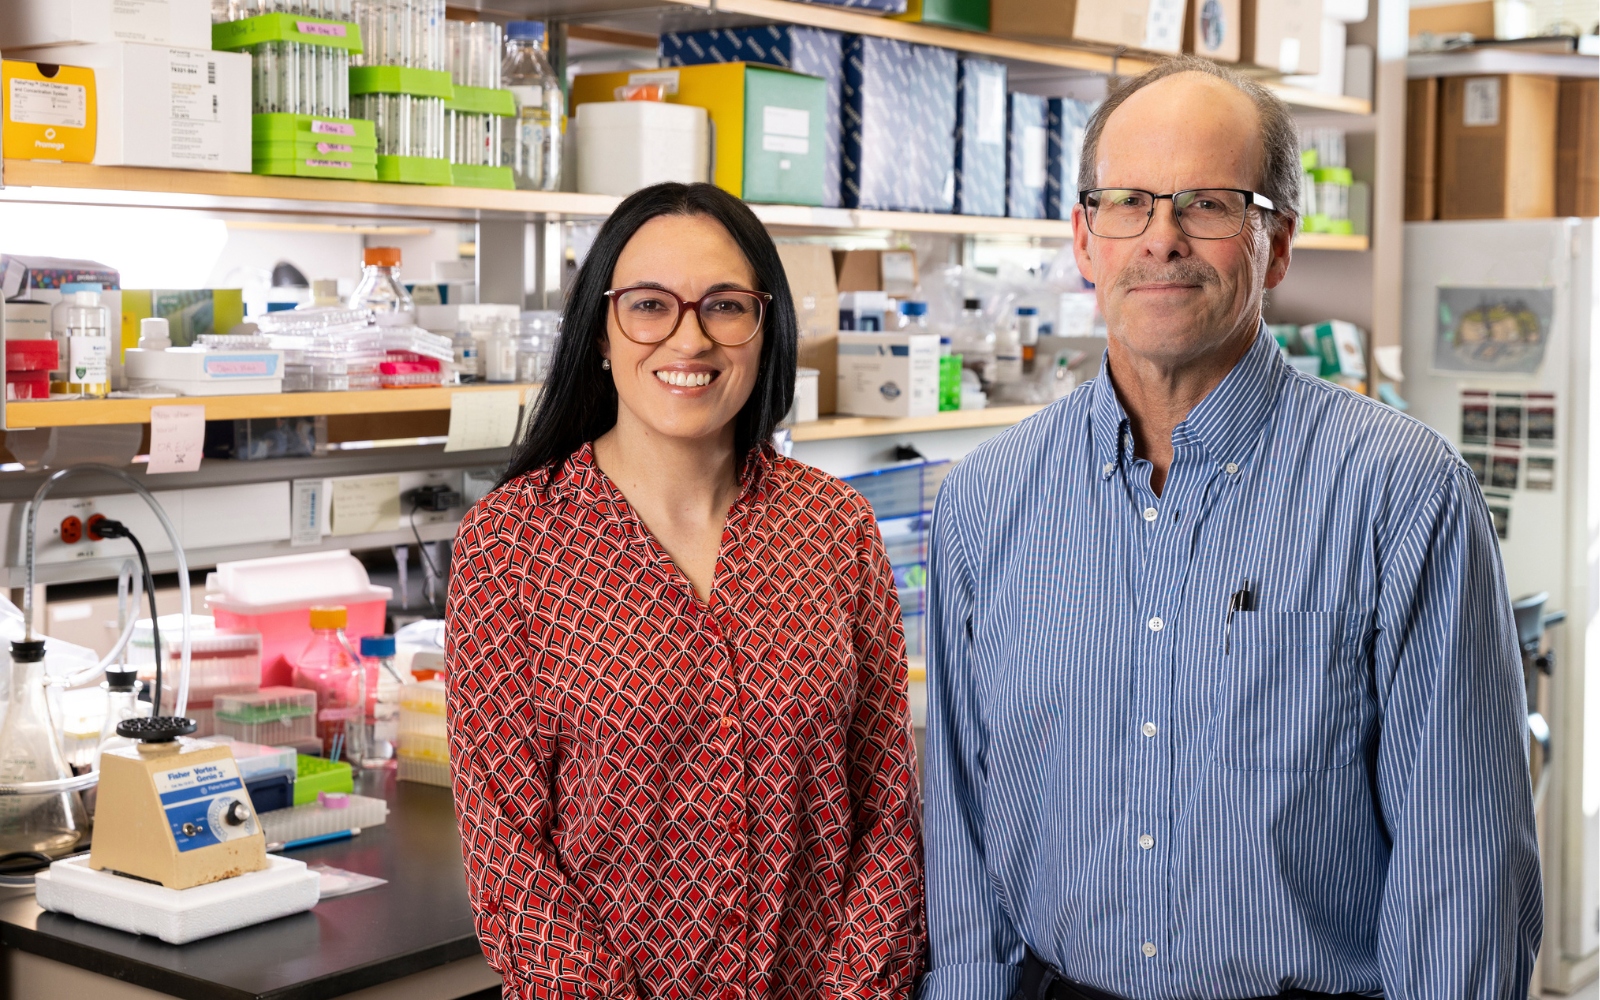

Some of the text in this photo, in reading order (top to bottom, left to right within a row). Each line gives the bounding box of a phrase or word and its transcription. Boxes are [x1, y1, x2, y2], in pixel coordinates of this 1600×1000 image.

[35, 140, 65, 151] Promega
[167, 765, 217, 781] Fisher Vortex
[196, 773, 218, 782] Genie
